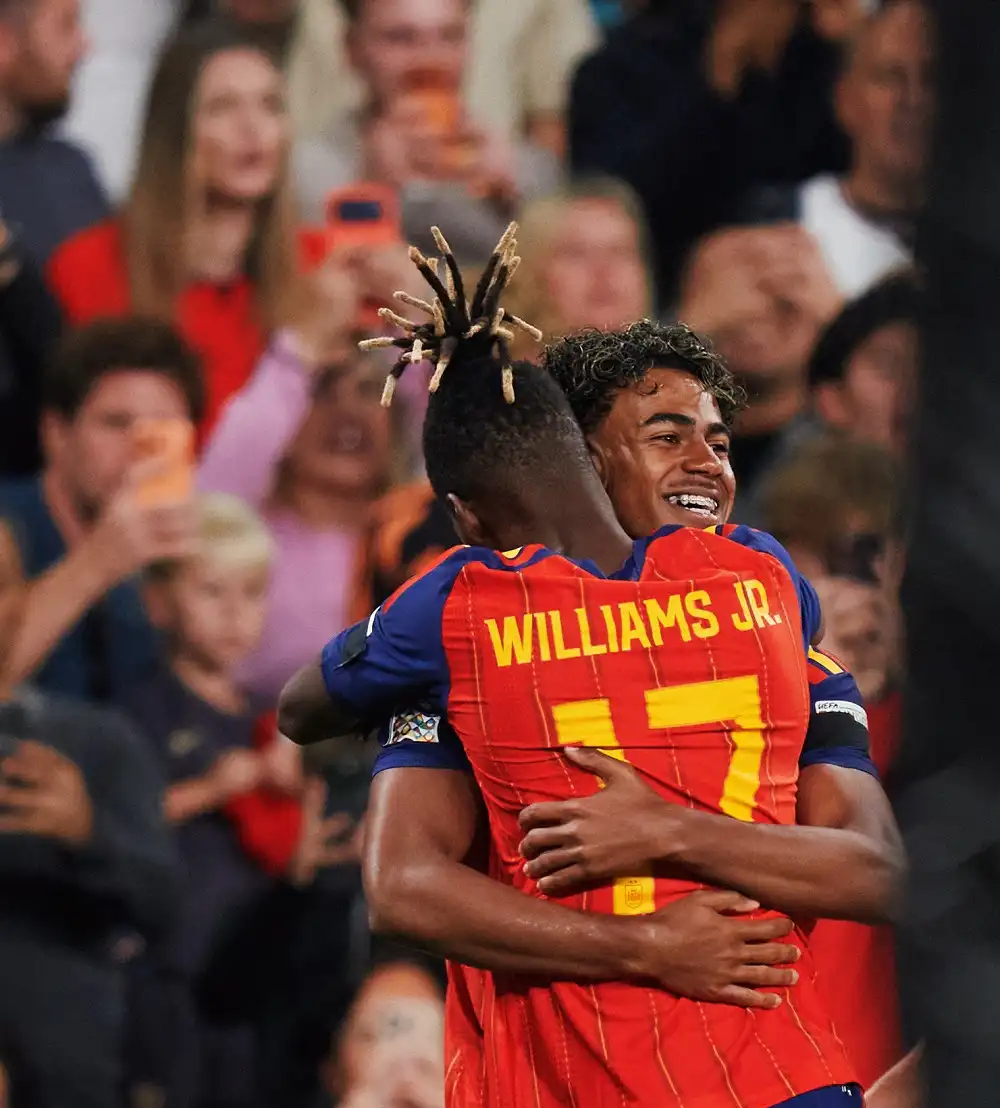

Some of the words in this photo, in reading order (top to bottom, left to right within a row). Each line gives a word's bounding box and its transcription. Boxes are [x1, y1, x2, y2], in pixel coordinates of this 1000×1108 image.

[484, 590, 719, 667] WILLIAMS
[733, 579, 782, 631] JR.
[818, 702, 838, 710] UEFA
